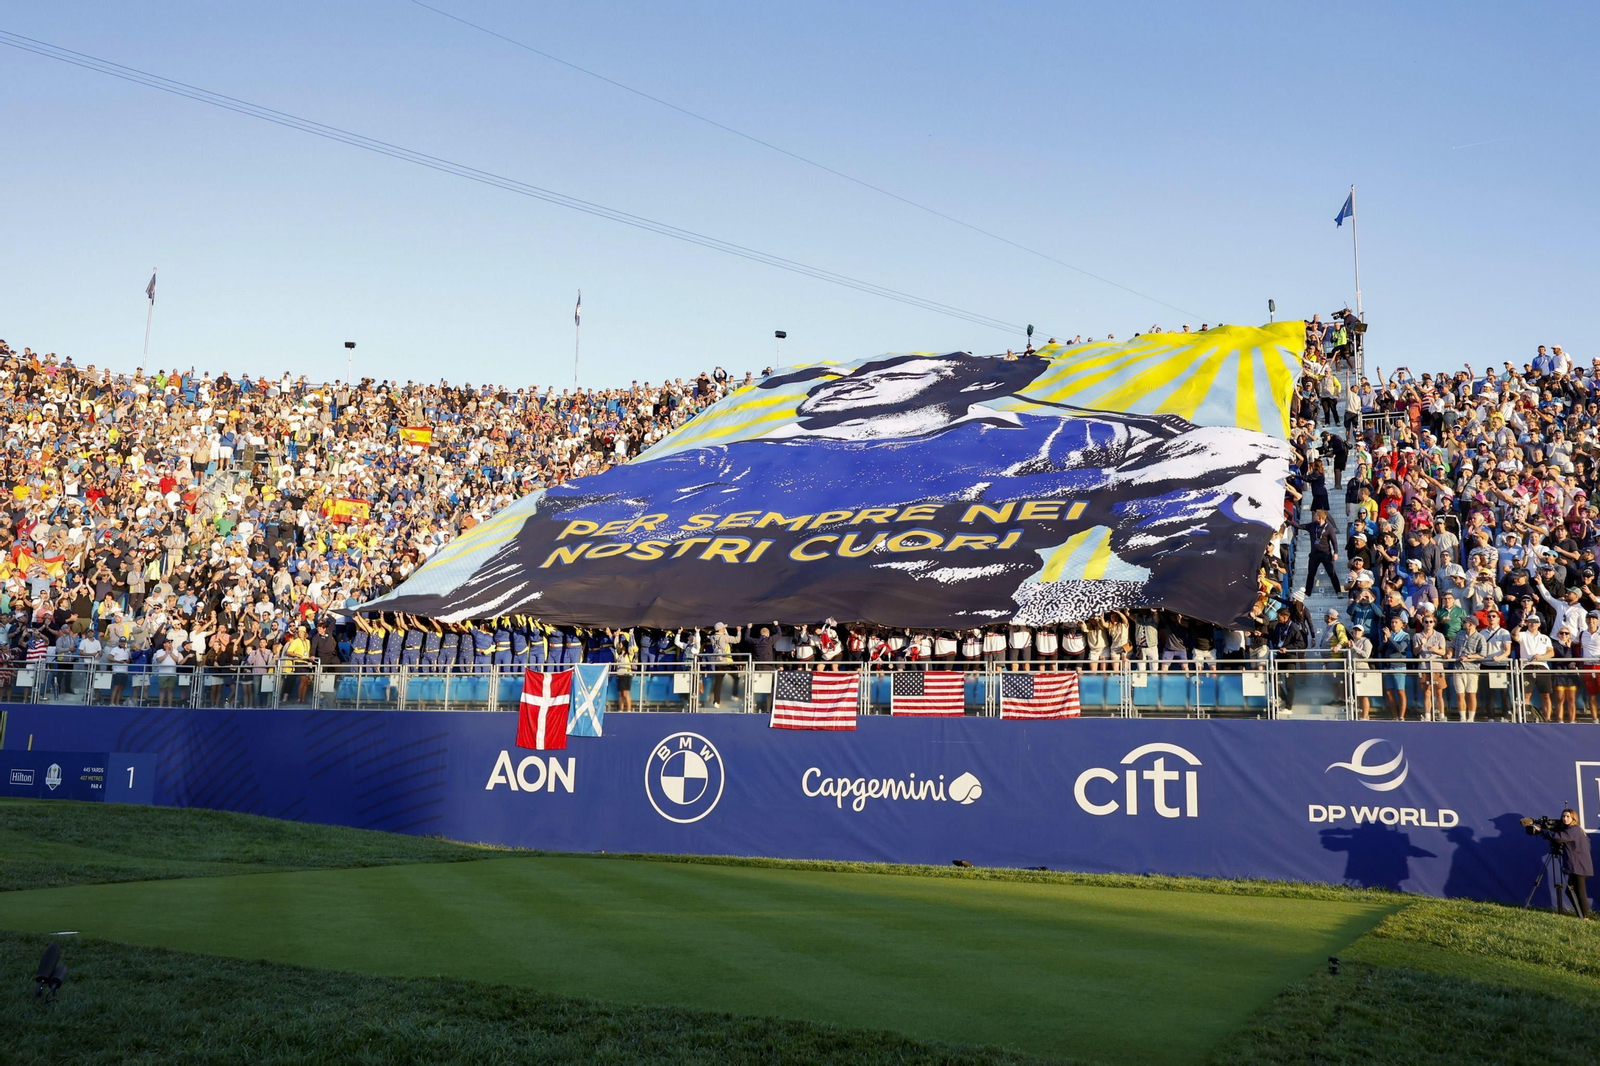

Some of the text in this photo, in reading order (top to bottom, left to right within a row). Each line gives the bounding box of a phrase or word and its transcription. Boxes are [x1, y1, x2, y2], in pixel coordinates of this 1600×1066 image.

[556, 500, 1088, 542] PER SEMPRE NEI
[538, 528, 1023, 569] NOSTRI CUORI
[656, 736, 715, 762] BMW
[12, 772, 32, 782] Hilton
[126, 766, 135, 789] 1
[485, 750, 576, 793] AON
[801, 767, 947, 812] Capgemini
[1073, 753, 1200, 819] citi
[1308, 804, 1459, 828] DP WORLD
